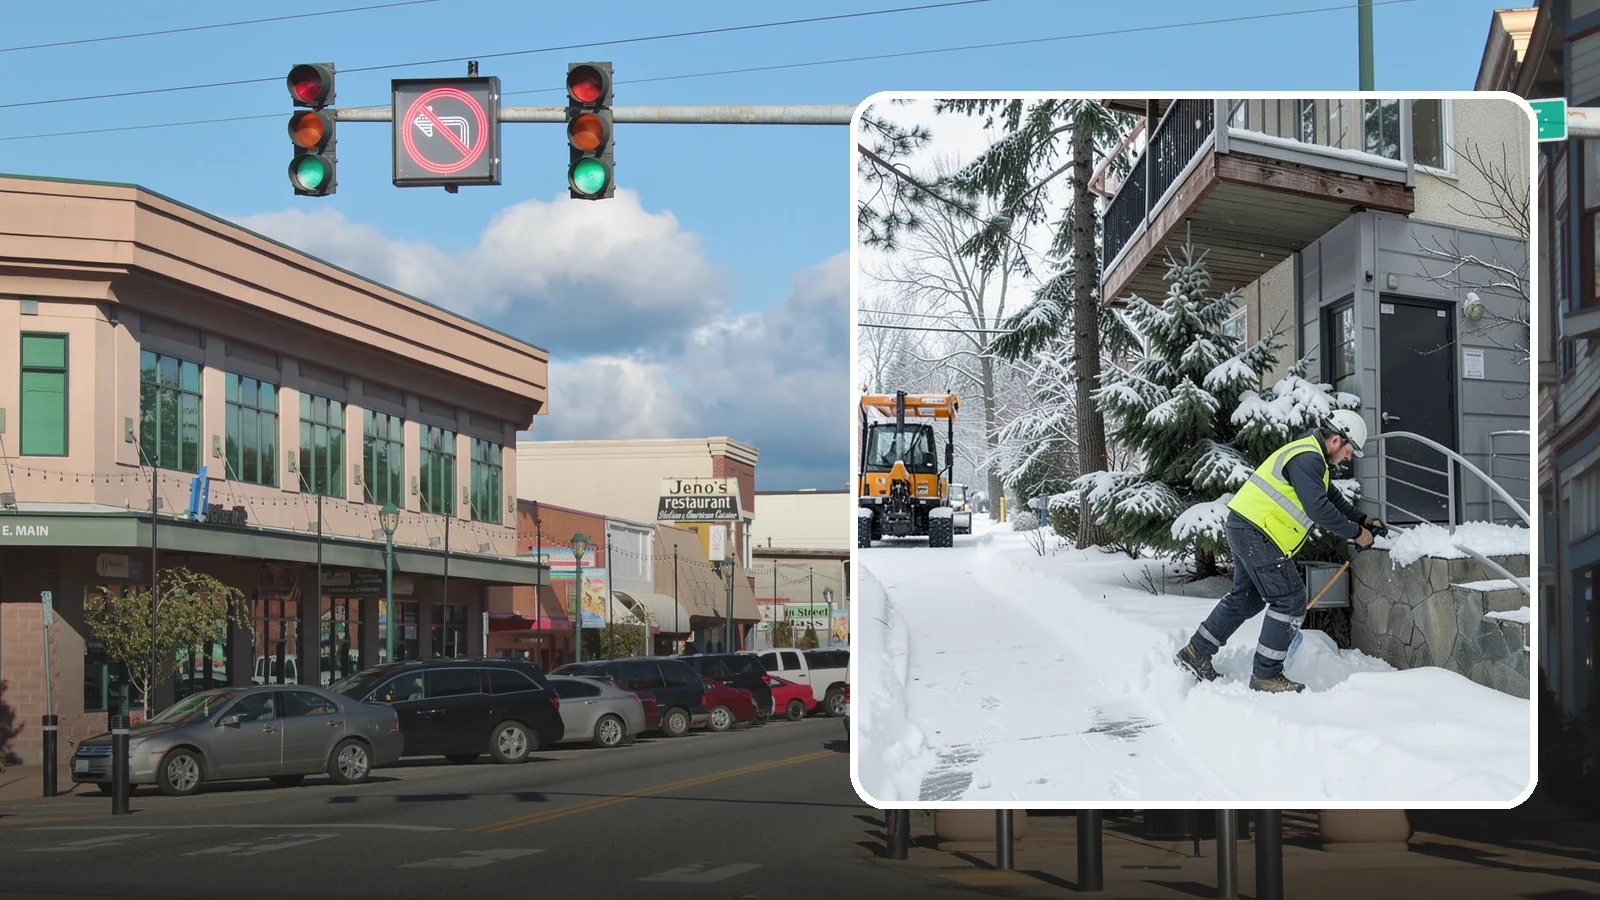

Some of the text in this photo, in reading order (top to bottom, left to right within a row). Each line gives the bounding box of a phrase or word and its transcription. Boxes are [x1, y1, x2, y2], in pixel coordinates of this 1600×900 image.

[670, 480, 728, 495] Jeno's
[665, 497, 731, 509] restaurant
[658, 510, 682, 520] Italian
[686, 510, 715, 519] American
[714, 510, 737, 519] Cuisine
[2, 525, 49, 536] E. MAIN
[797, 607, 829, 617] Street
[790, 619, 824, 627] lass
